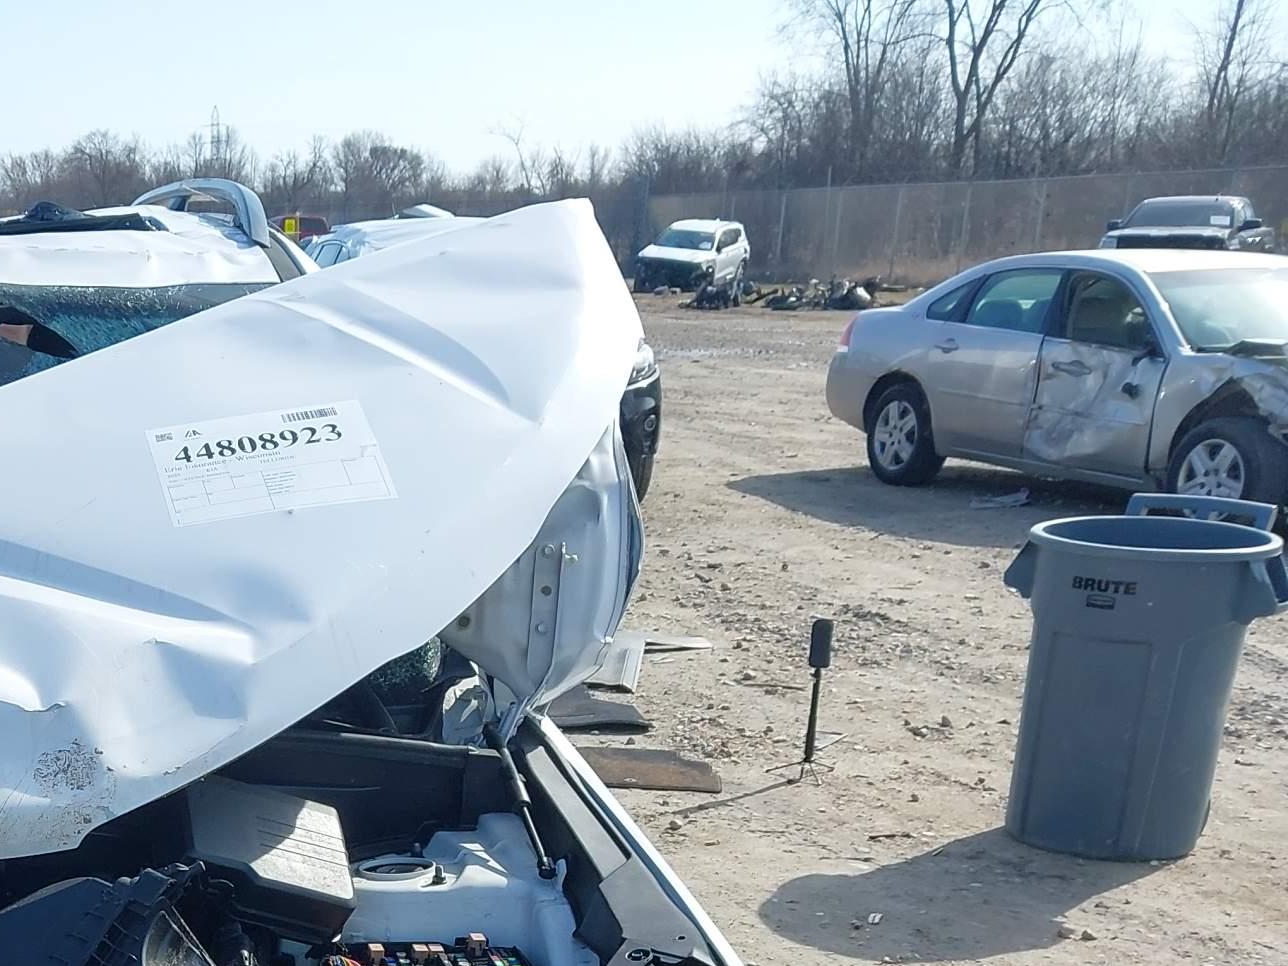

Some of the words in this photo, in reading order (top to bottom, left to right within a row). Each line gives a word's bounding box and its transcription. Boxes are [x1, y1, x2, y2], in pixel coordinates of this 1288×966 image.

[174, 423, 342, 463] 44808923
[235, 451, 281, 462] Wisconsin
[1072, 575, 1138, 596] BRUTE
